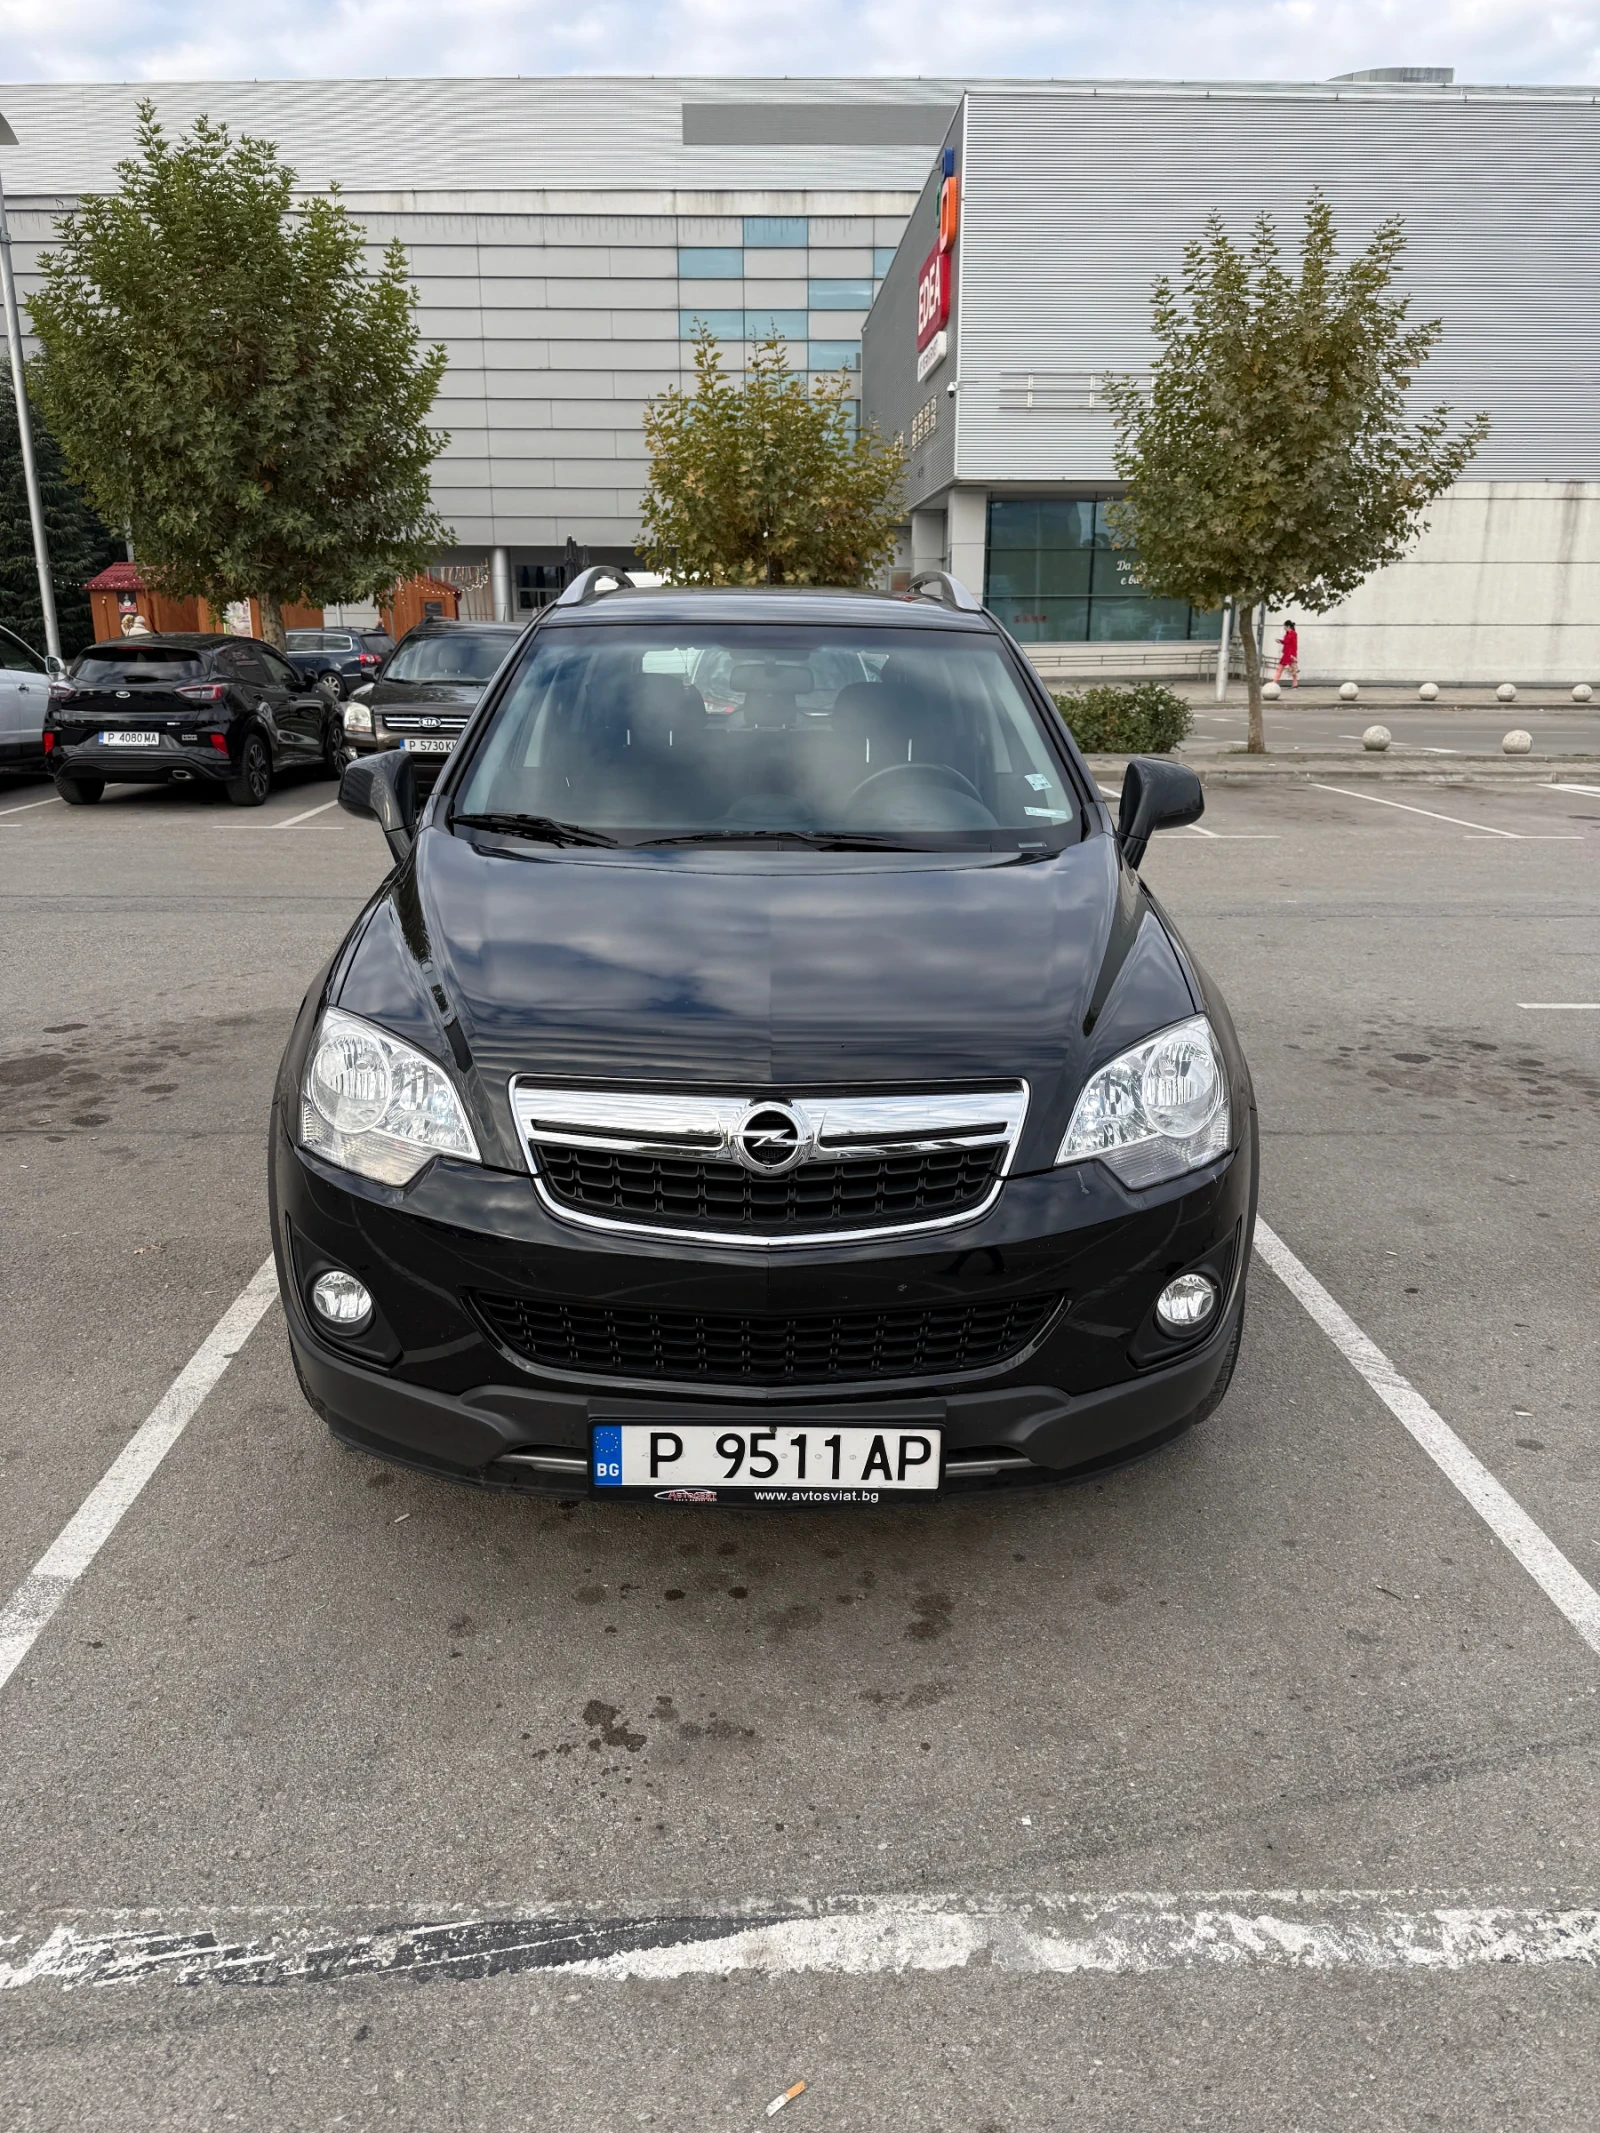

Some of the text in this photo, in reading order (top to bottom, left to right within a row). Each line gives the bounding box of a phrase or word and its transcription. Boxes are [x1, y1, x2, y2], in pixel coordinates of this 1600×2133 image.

[918, 255, 941, 337] EDEA
[422, 718, 438, 726] KIA
[108, 732, 115, 743] P
[409, 740, 416, 750] P
[650, 1432, 684, 1479] P
[596, 1463, 620, 1477] BG
[754, 1490, 879, 1503] www.avtosviat.bg
